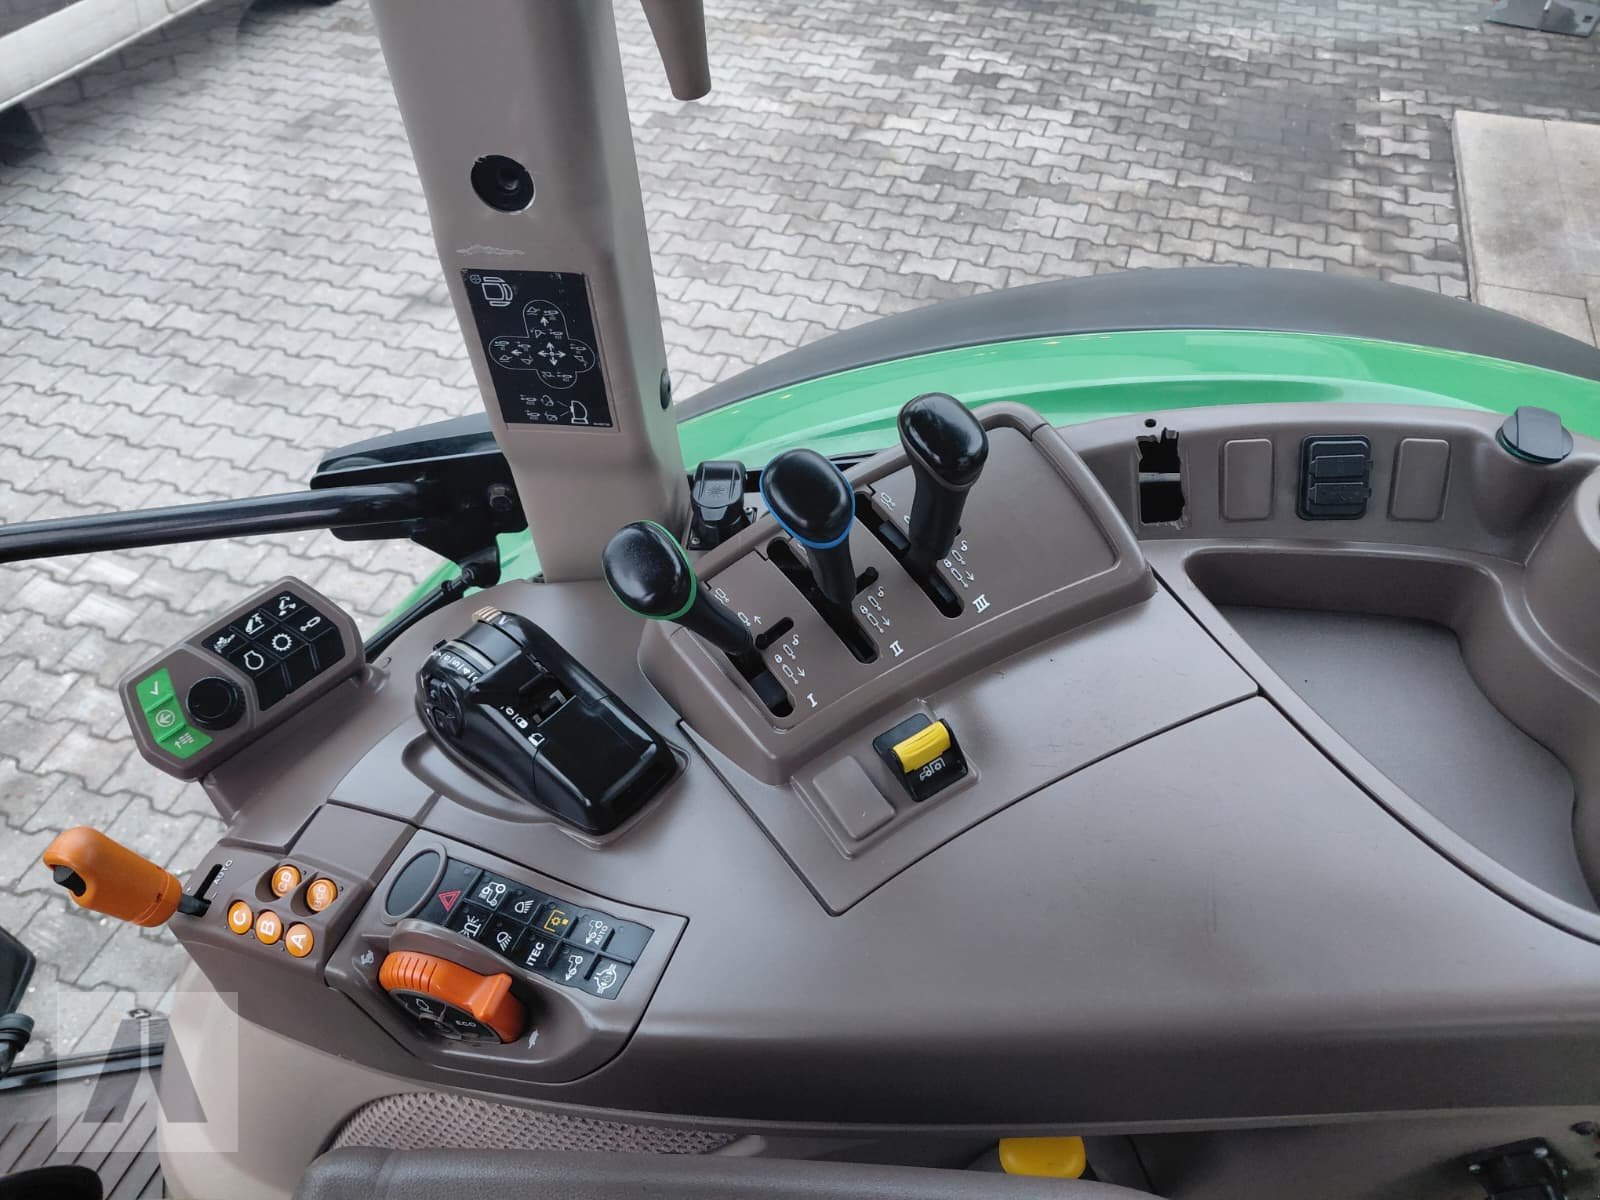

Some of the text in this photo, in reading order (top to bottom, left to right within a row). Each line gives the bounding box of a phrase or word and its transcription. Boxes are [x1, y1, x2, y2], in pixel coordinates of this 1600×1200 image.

[972, 594, 990, 613] III
[889, 639, 904, 656] II
[233, 911, 247, 926] C
[260, 920, 276, 936] B
[594, 925, 608, 945] AUTO
[290, 934, 308, 950] A
[525, 942, 545, 967] ITEC
